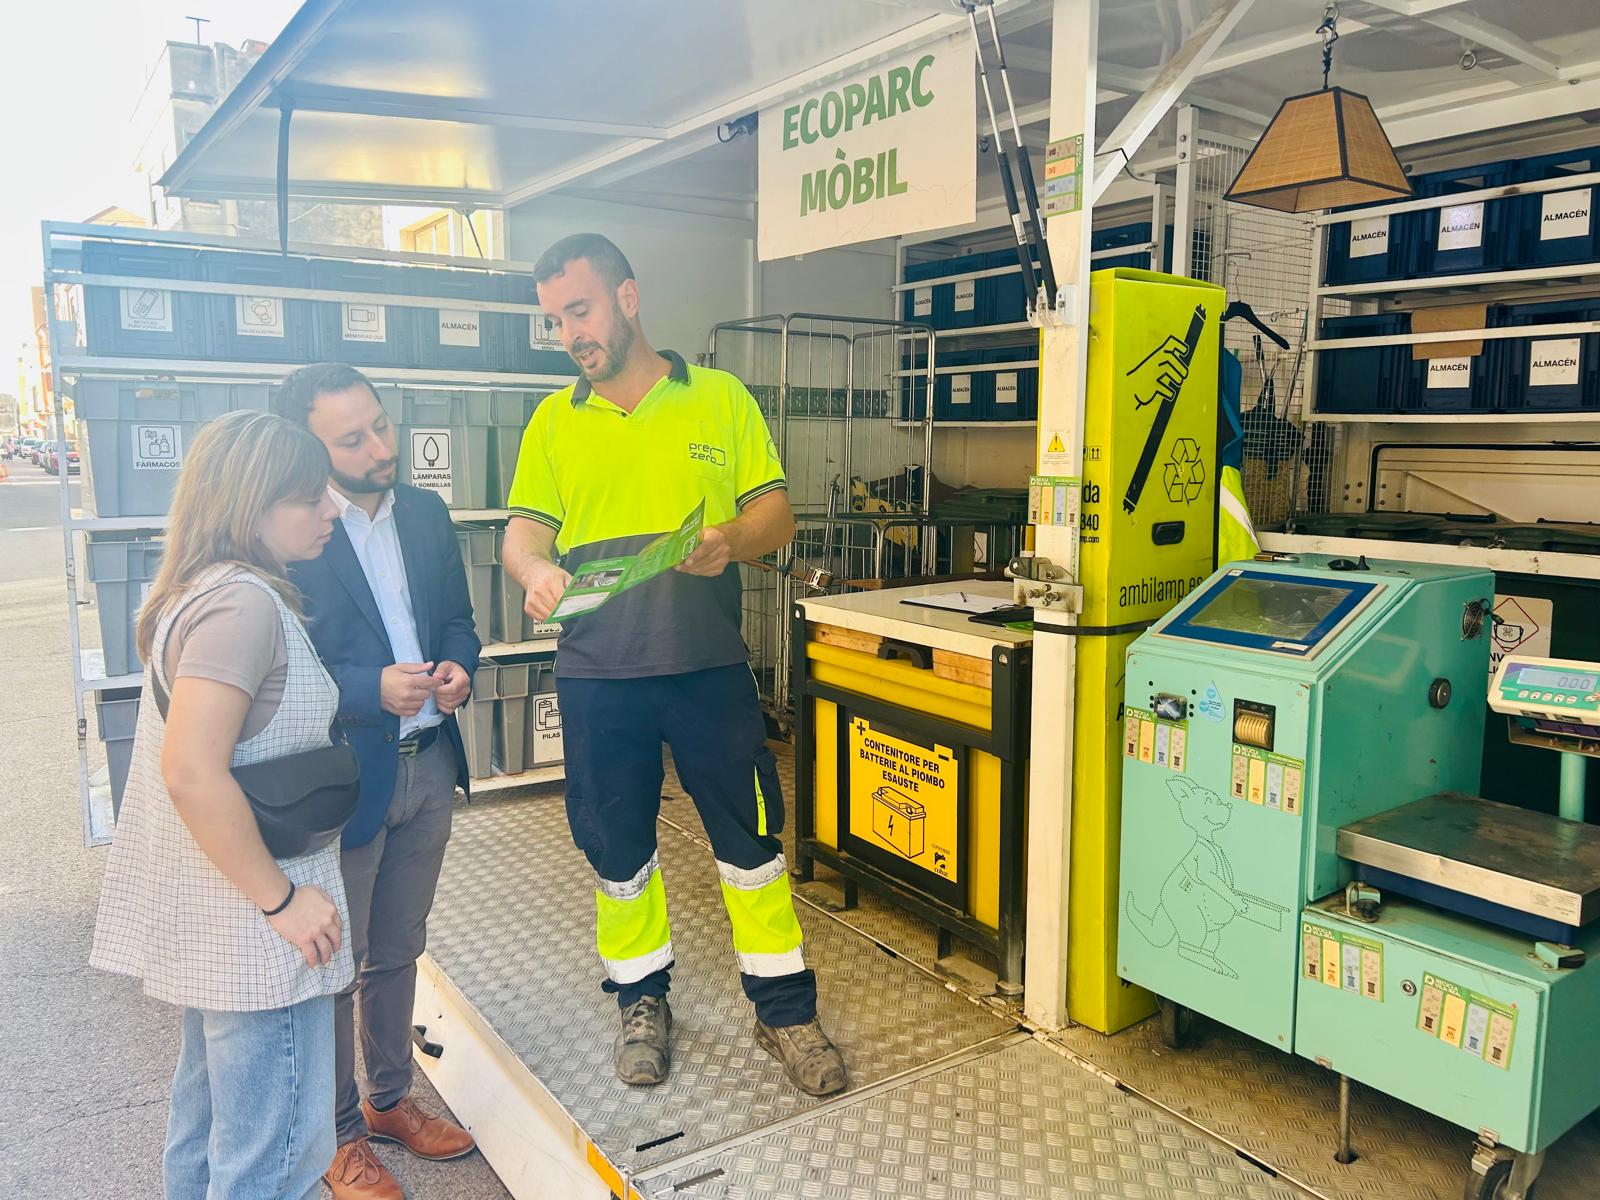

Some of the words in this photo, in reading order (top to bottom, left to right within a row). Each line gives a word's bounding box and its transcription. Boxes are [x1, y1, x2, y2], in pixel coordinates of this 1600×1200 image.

[783, 54, 936, 152] ECOPARC
[800, 147, 908, 218] MÒBIL
[1543, 208, 1588, 222] ALMACÉN
[1441, 221, 1481, 234] ALMACÉN
[1352, 229, 1387, 242] ALMACÉN
[441, 321, 478, 331] ALMACÉN
[1430, 363, 1468, 372] ALMACÉN
[1532, 358, 1577, 368] ALMACÉN
[688, 442, 710, 452] pre
[690, 451, 717, 464] zero
[542, 731, 561, 740] PILAS
[864, 737, 920, 767] CONTENITORE
[922, 759, 940, 774] PER
[860, 748, 897, 771] BATTERIE
[899, 763, 910, 776] AL
[911, 768, 945, 789] PIOMBO
[882, 770, 919, 792] ESAUSTE
